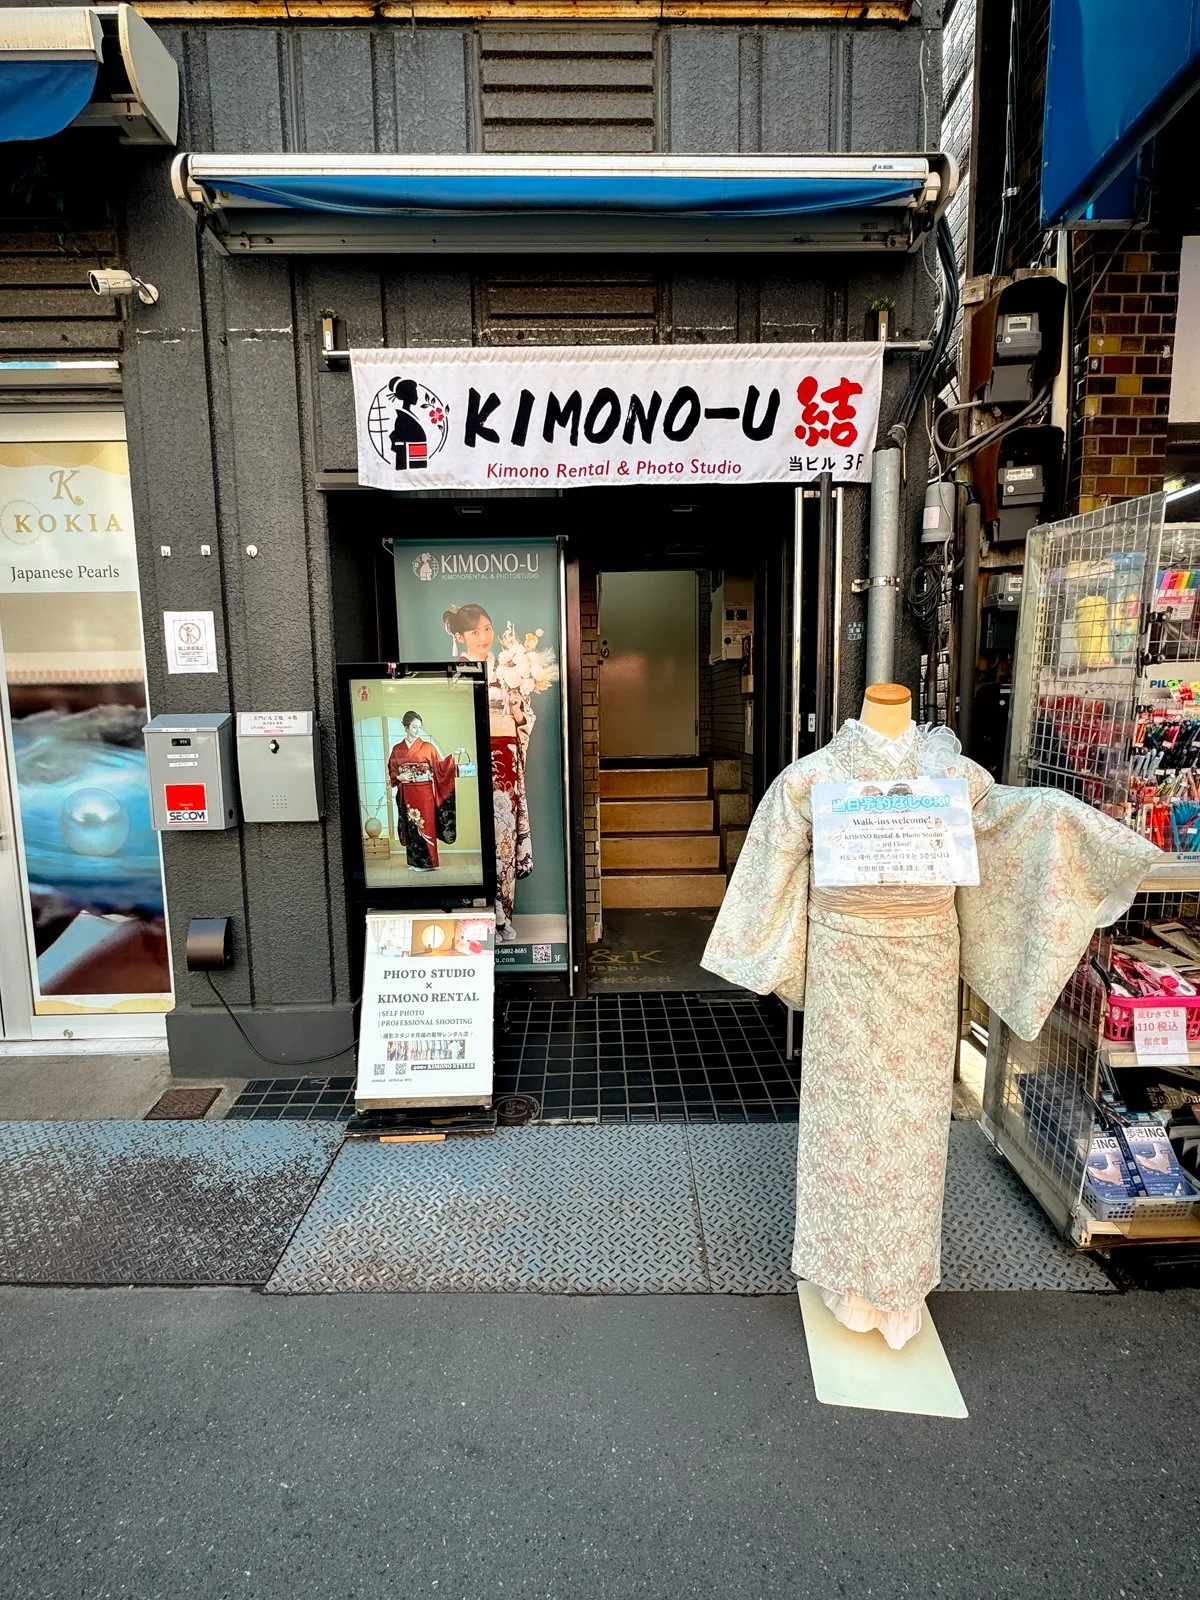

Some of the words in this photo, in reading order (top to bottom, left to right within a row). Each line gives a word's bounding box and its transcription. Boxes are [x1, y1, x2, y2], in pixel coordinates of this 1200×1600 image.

[464, 385, 780, 448] KIMONO-U
[794, 376, 863, 447] 結
[486, 462, 549, 479] Kimono
[556, 460, 610, 478] Rental
[616, 460, 630, 475] &
[636, 460, 684, 475] Photo
[691, 458, 742, 474] Studio
[789, 455, 836, 472] 当ビル
[843, 453, 864, 470] 3F
[14, 513, 123, 533] KOKIA
[441, 553, 539, 573] KIMONO-U
[11, 566, 73, 583] Japanese
[78, 565, 120, 578] Pearls
[1150, 679, 1183, 688] PIL
[169, 811, 205, 821] SECOM
[853, 817, 890, 826] Walk-ins
[892, 816, 931, 825] welcome!
[553, 955, 562, 963] 3F
[383, 969, 426, 979] PHOTO
[430, 968, 476, 978] STUDIO
[377, 993, 429, 1004] KIMONO
[431, 992, 480, 1002] RENTAL
[381, 1019, 434, 1027] PROFESSIONAL
